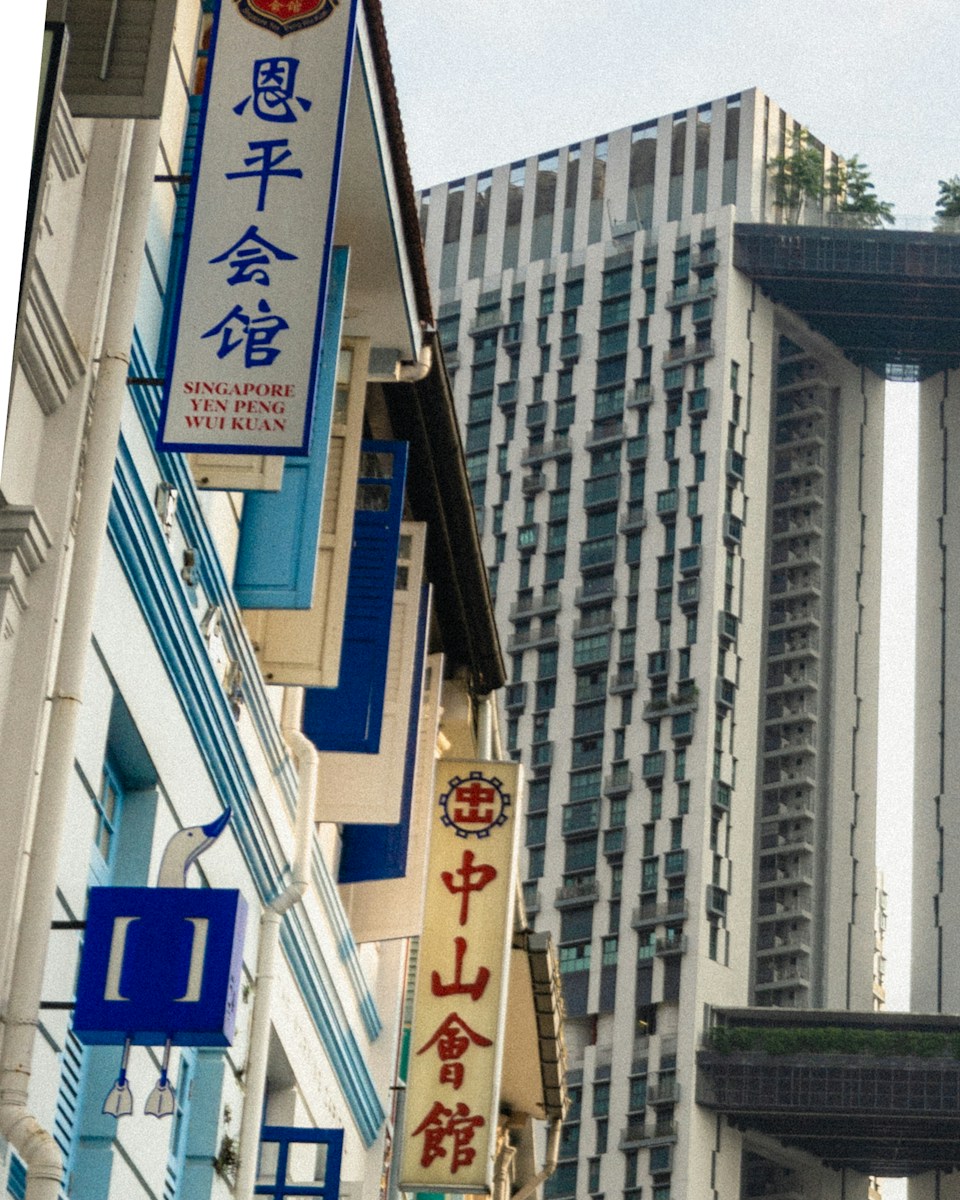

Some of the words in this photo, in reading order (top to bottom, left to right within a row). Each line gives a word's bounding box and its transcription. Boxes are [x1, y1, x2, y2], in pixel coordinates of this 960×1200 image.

[201, 56, 312, 369] 恩平会馆
[183, 381, 295, 398] SINGAPORE
[190, 398, 228, 412] YEN
[234, 400, 286, 414] PENG
[184, 415, 226, 430] WUI
[231, 417, 287, 431] KUAN
[411, 849, 498, 1174] 中山會館
